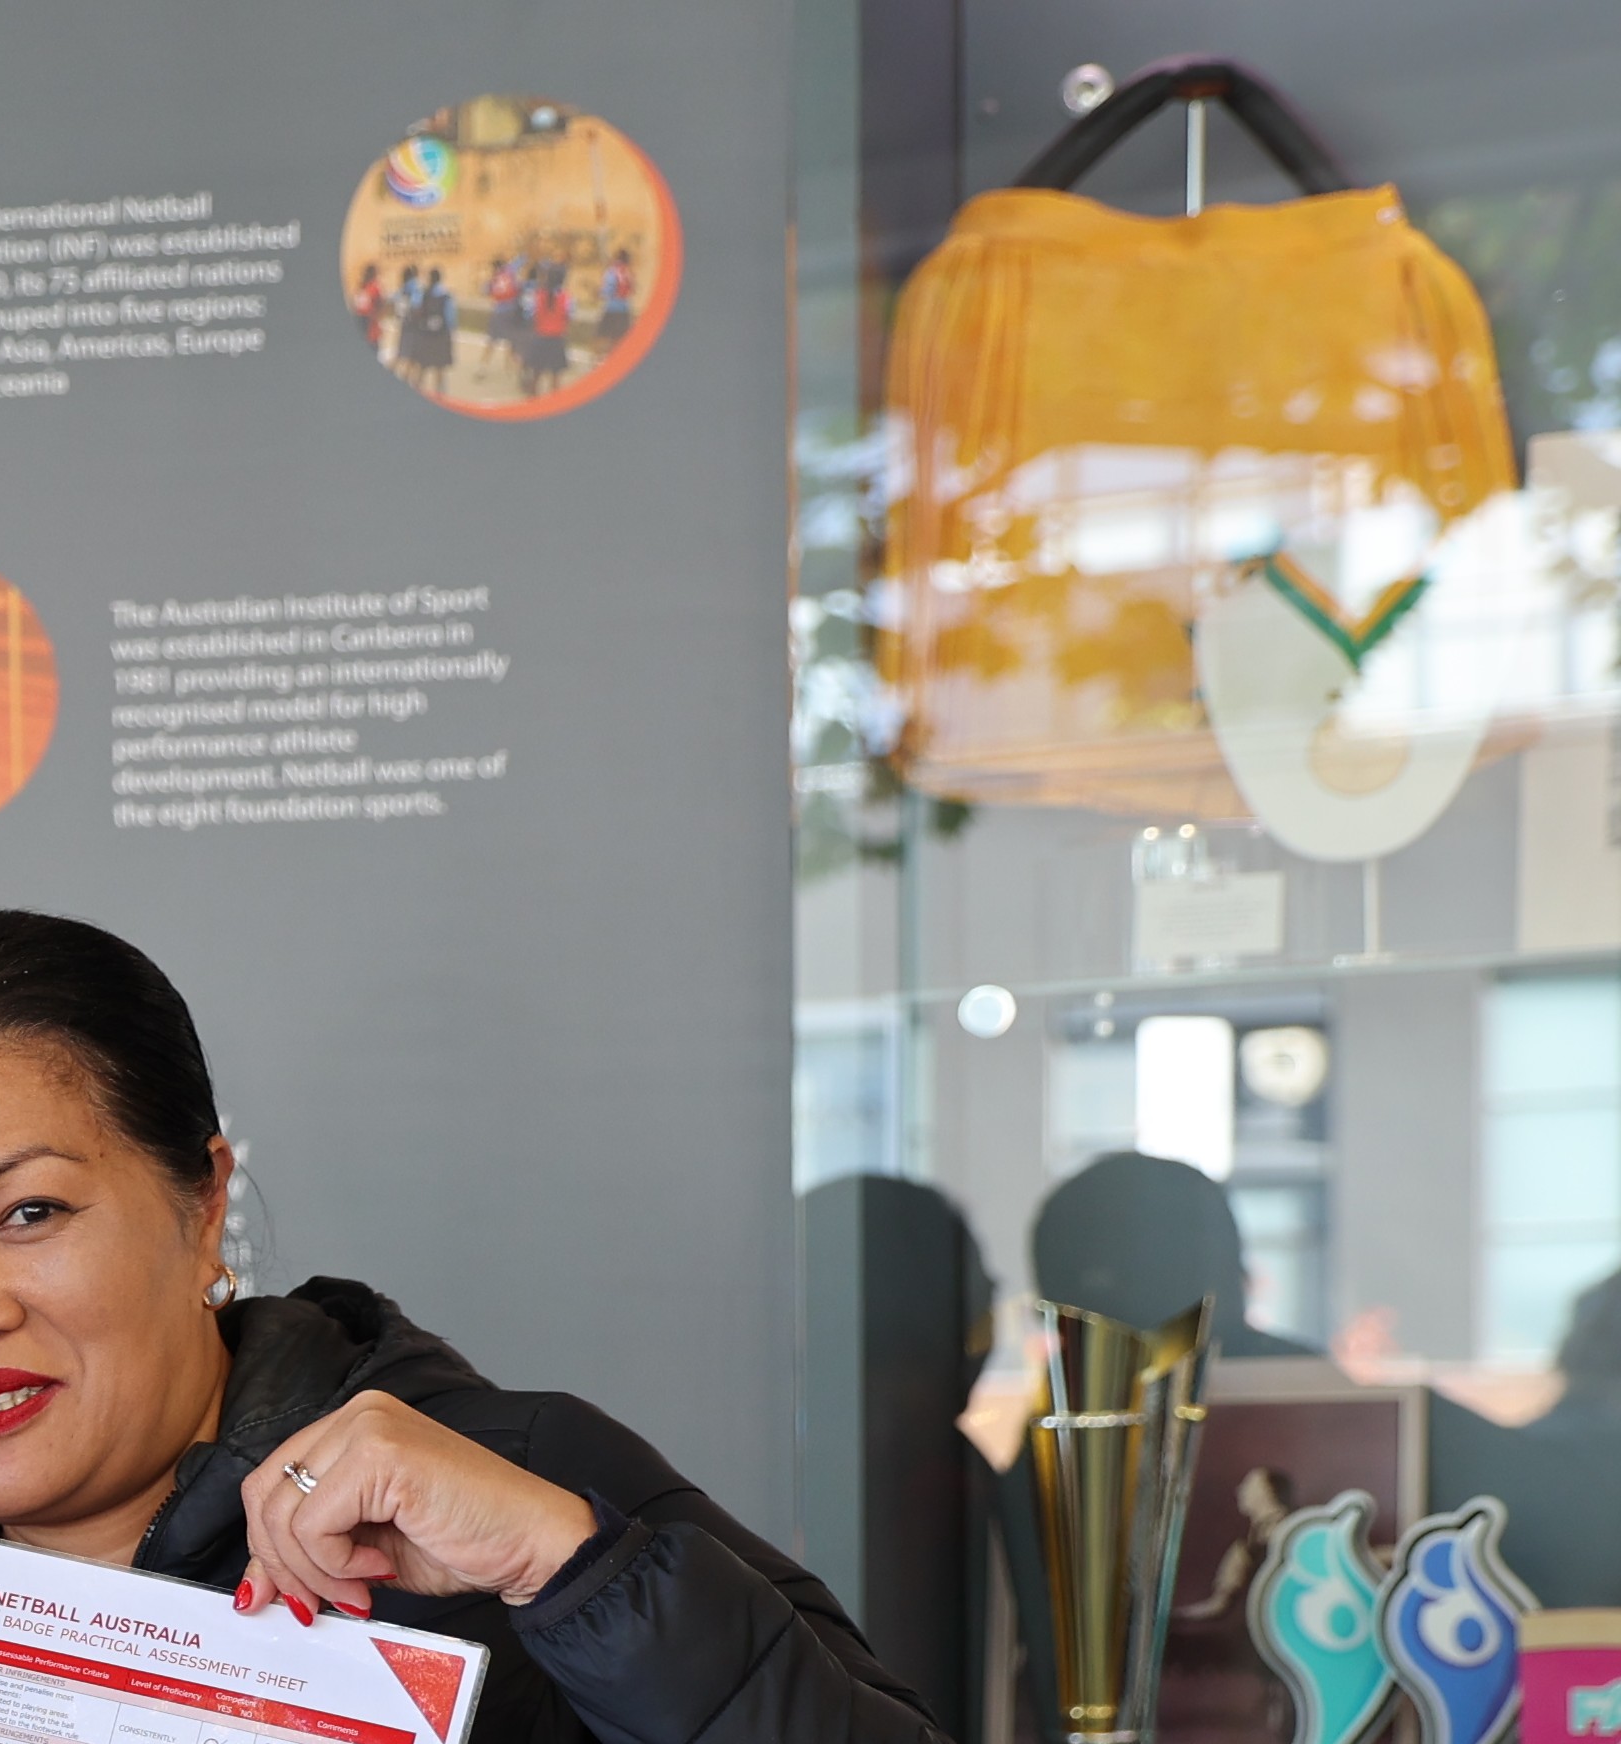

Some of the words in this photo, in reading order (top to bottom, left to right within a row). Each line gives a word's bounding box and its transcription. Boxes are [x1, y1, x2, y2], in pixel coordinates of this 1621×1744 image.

[88, 1611, 201, 1650] AUSTRALIA
[1, 1614, 55, 1638] BADGE
[58, 1626, 142, 1657] PRACTICAL
[146, 1646, 252, 1680] ASSESSMENT
[254, 1669, 309, 1693] SHEET
[3, 1667, 66, 1687] INFRINGEMENTS
[33, 1655, 82, 1674] Performance
[81, 1666, 111, 1680] Criteria
[129, 1677, 153, 1690] Level
[151, 1682, 162, 1691] of
[160, 1684, 203, 1703] Proficiency
[214, 1691, 259, 1709] Competent
[216, 1702, 233, 1715] YES
[239, 1708, 254, 1719] NO
[117, 1723, 177, 1743] CONSISTENTLY
[315, 1719, 359, 1737] Comments
